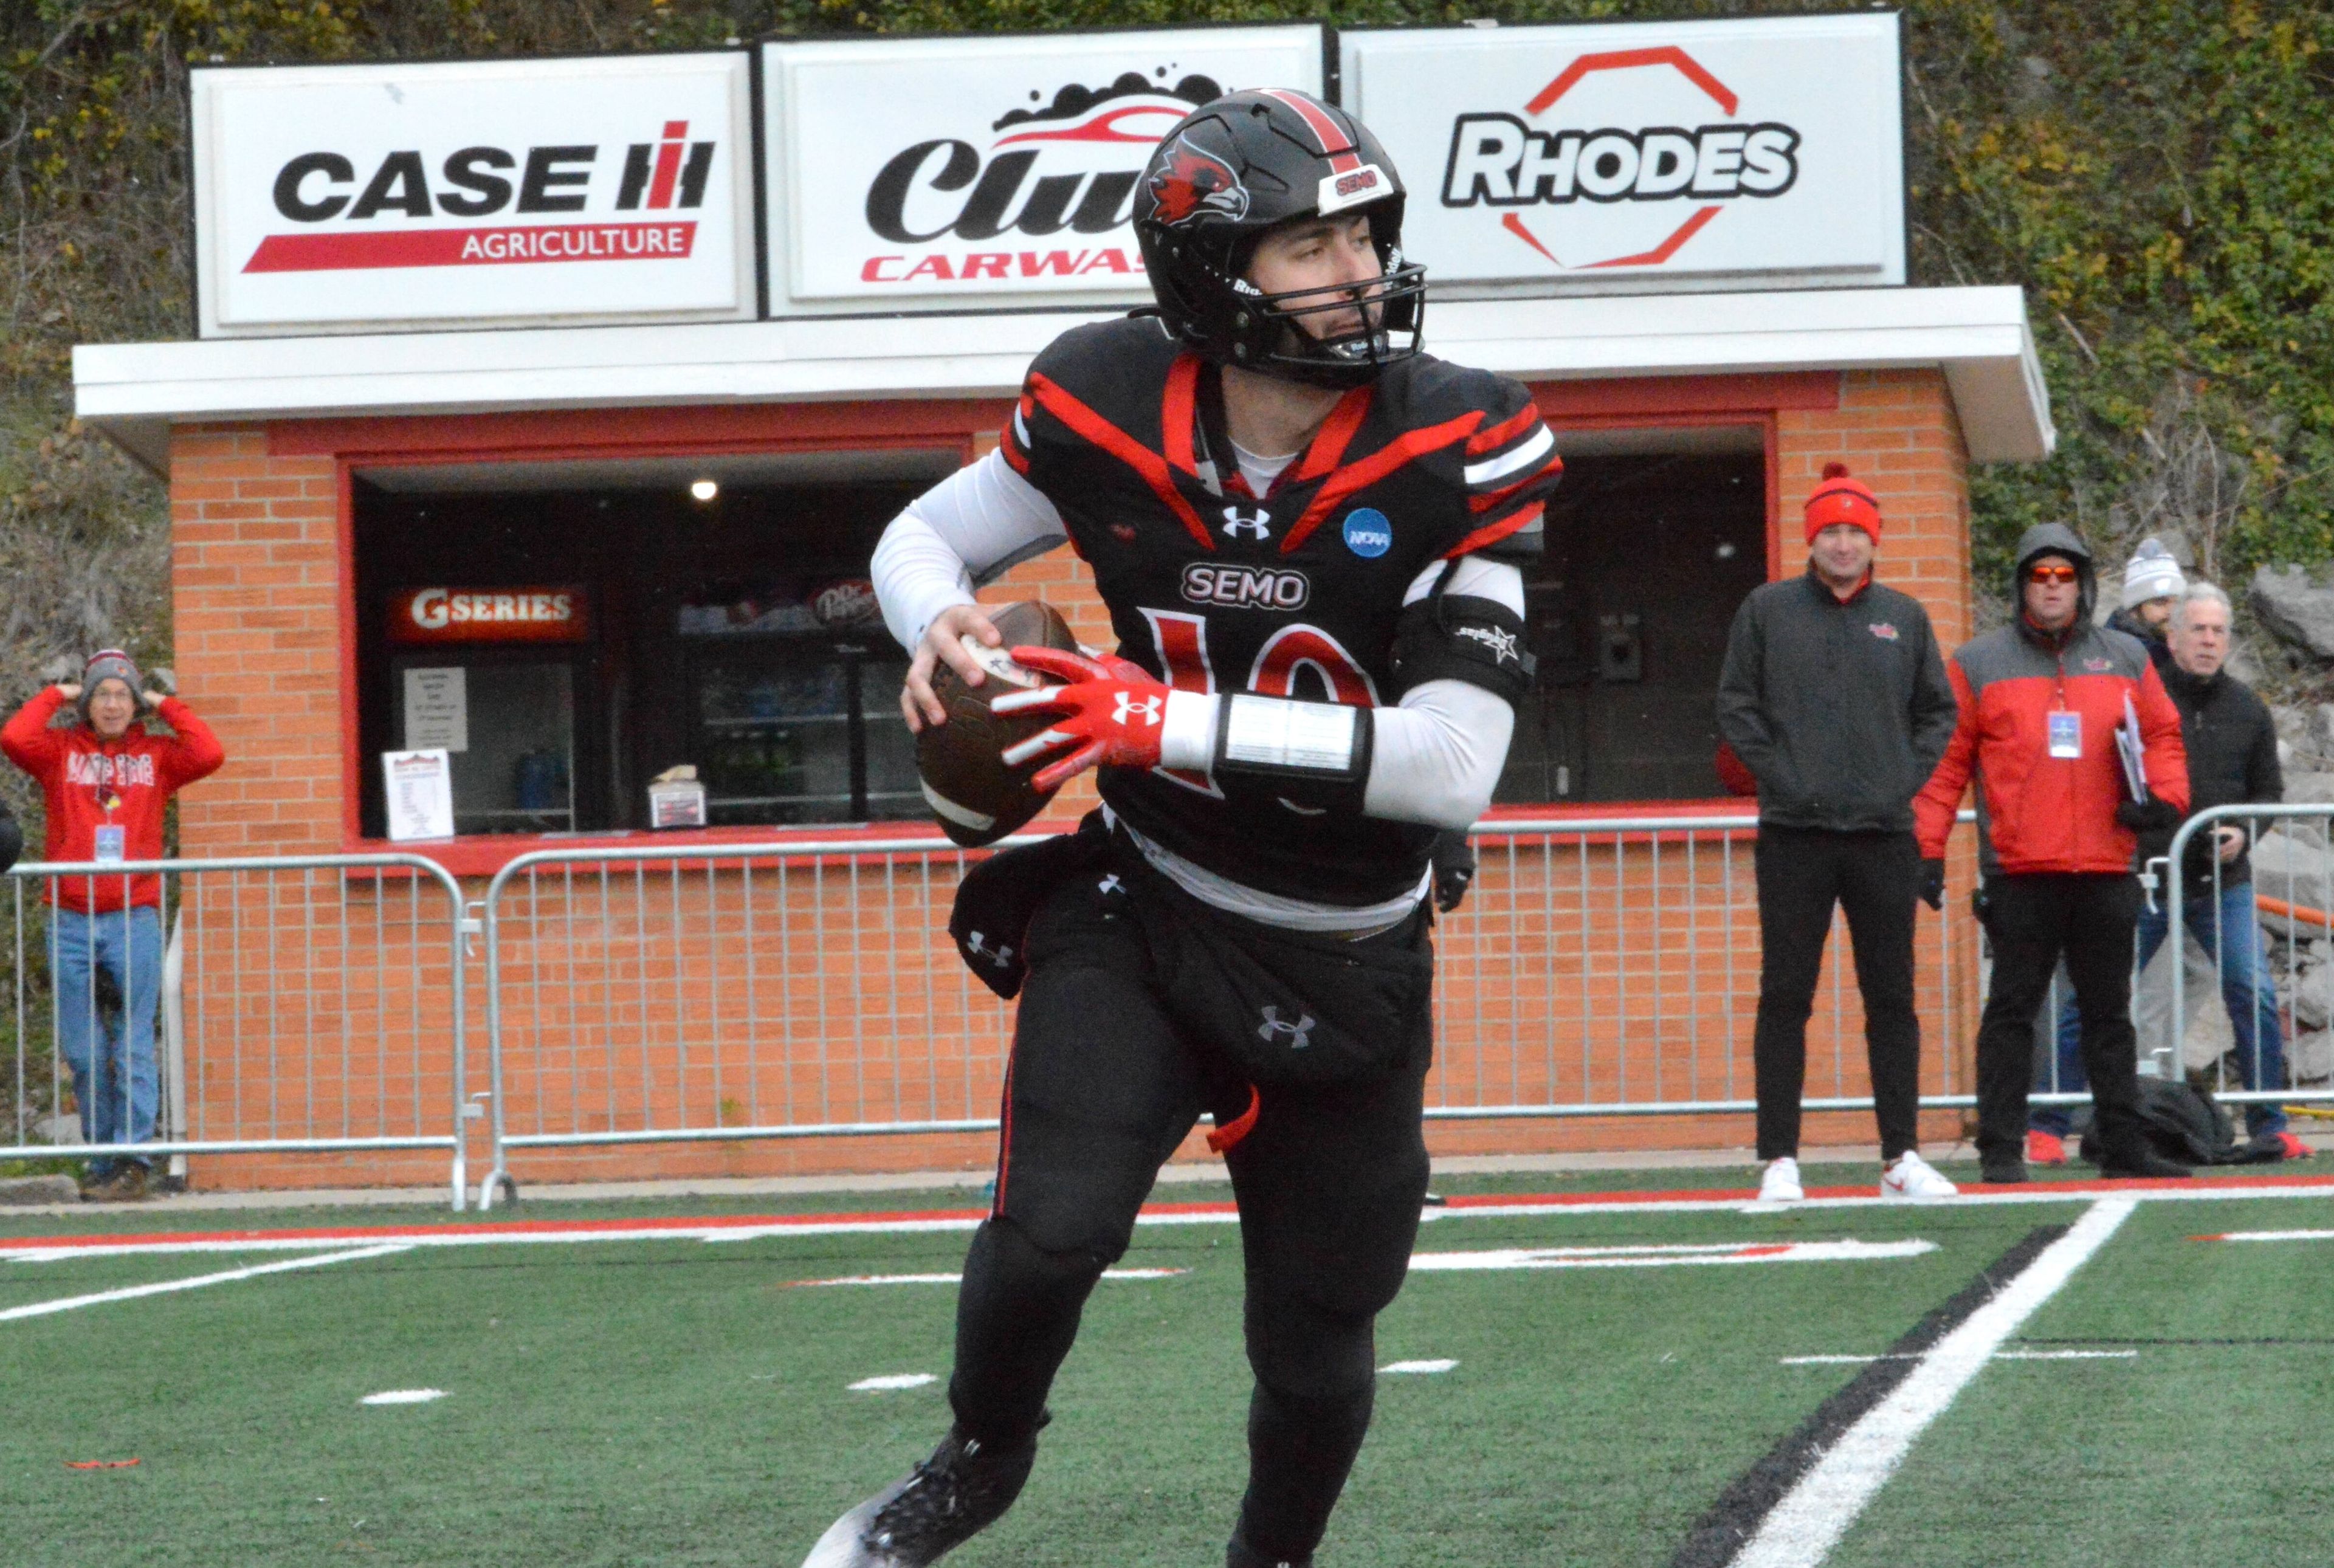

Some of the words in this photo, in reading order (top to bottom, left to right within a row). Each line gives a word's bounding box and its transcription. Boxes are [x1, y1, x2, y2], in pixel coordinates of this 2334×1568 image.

[1442, 112, 1801, 208] RHODES
[272, 145, 599, 223] CASE
[866, 139, 1143, 242] Clu
[1336, 170, 1377, 196] SEMO
[461, 227, 683, 260] AGRICULTURE
[1349, 531, 1389, 546] NCAA
[1186, 567, 1305, 606] SEMO
